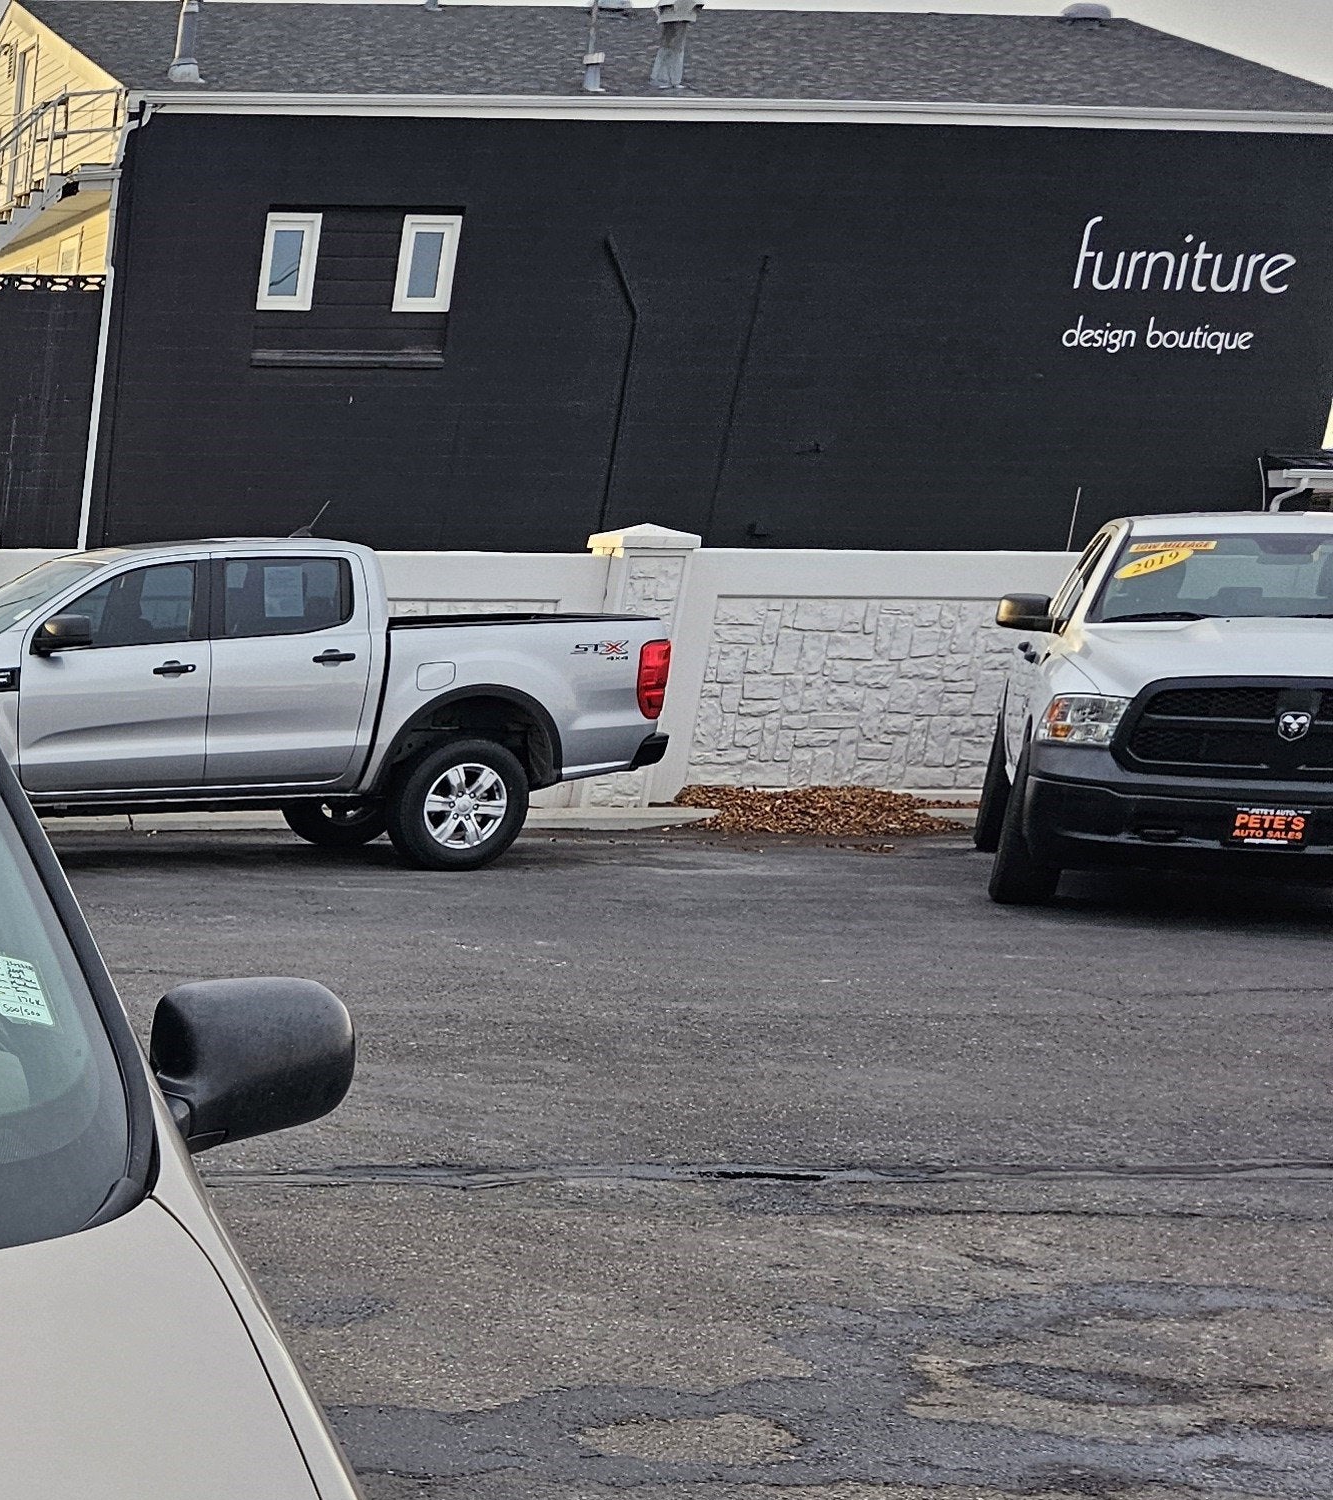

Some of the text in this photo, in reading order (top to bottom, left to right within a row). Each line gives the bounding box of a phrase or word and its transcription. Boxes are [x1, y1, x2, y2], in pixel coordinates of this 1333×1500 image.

[1073, 216, 1296, 293] furniture
[1062, 315, 1254, 354] design boutique
[1160, 541, 1210, 549] MILEAGE
[1132, 551, 1180, 574] 2019
[571, 640, 629, 655] STX
[1235, 813, 1305, 830] PETE'S
[1233, 829, 1303, 840] AUTO SALES
